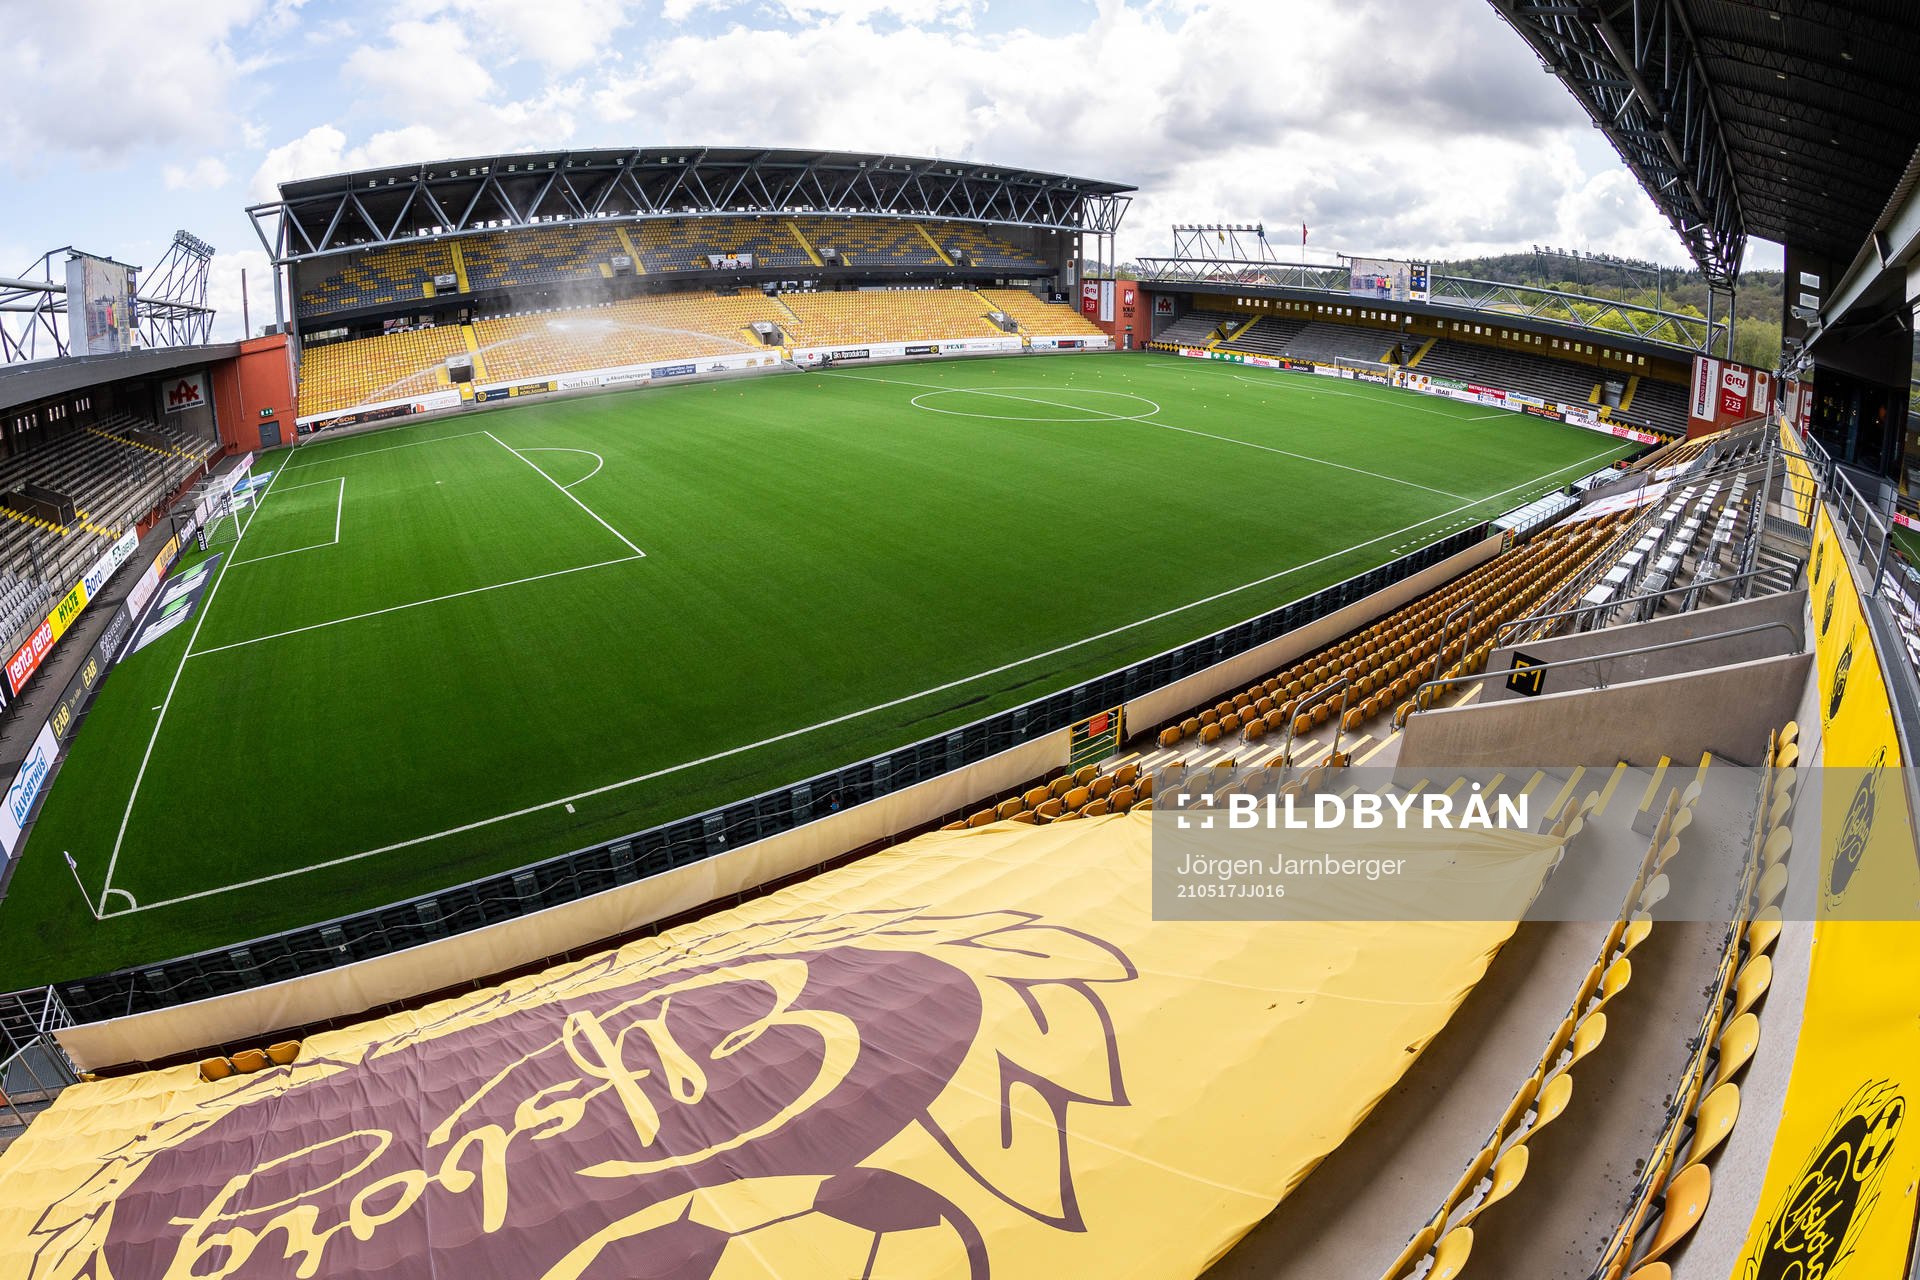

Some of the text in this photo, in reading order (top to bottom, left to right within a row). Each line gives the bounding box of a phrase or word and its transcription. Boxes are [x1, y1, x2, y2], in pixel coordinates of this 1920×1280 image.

[1724, 373, 1746, 389] City
[1725, 399, 1741, 410] 7-23
[1577, 418, 1601, 428] ATRACCO
[58, 591, 79, 623] HYLTE
[83, 660, 97, 687] EAB
[53, 706, 70, 737] EAB
[15, 756, 47, 821] ÄLVSBYHUS
